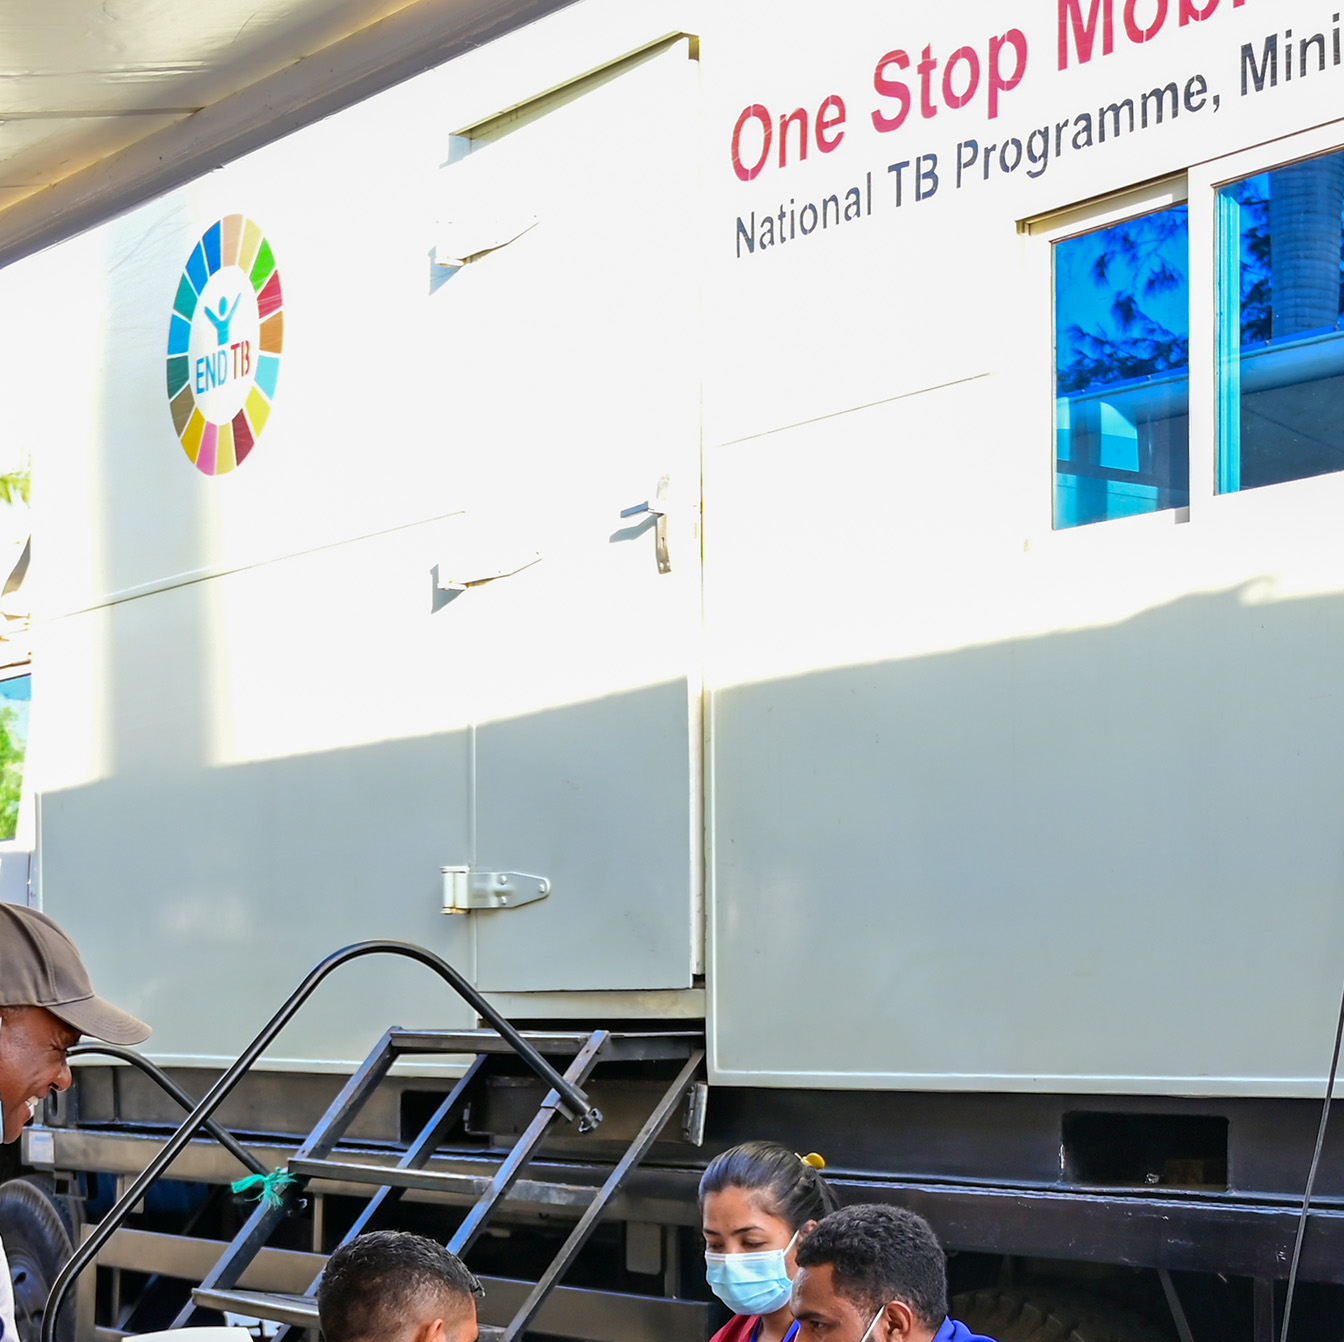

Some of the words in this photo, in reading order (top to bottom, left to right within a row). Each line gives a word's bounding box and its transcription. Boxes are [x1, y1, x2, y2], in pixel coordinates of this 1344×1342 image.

[731, 95, 846, 181] One
[871, 28, 1027, 133] Stop
[737, 172, 871, 258] National
[888, 153, 938, 207] TB
[956, 74, 1220, 188] Programme,
[196, 350, 227, 395] END
[231, 340, 250, 379] TB
